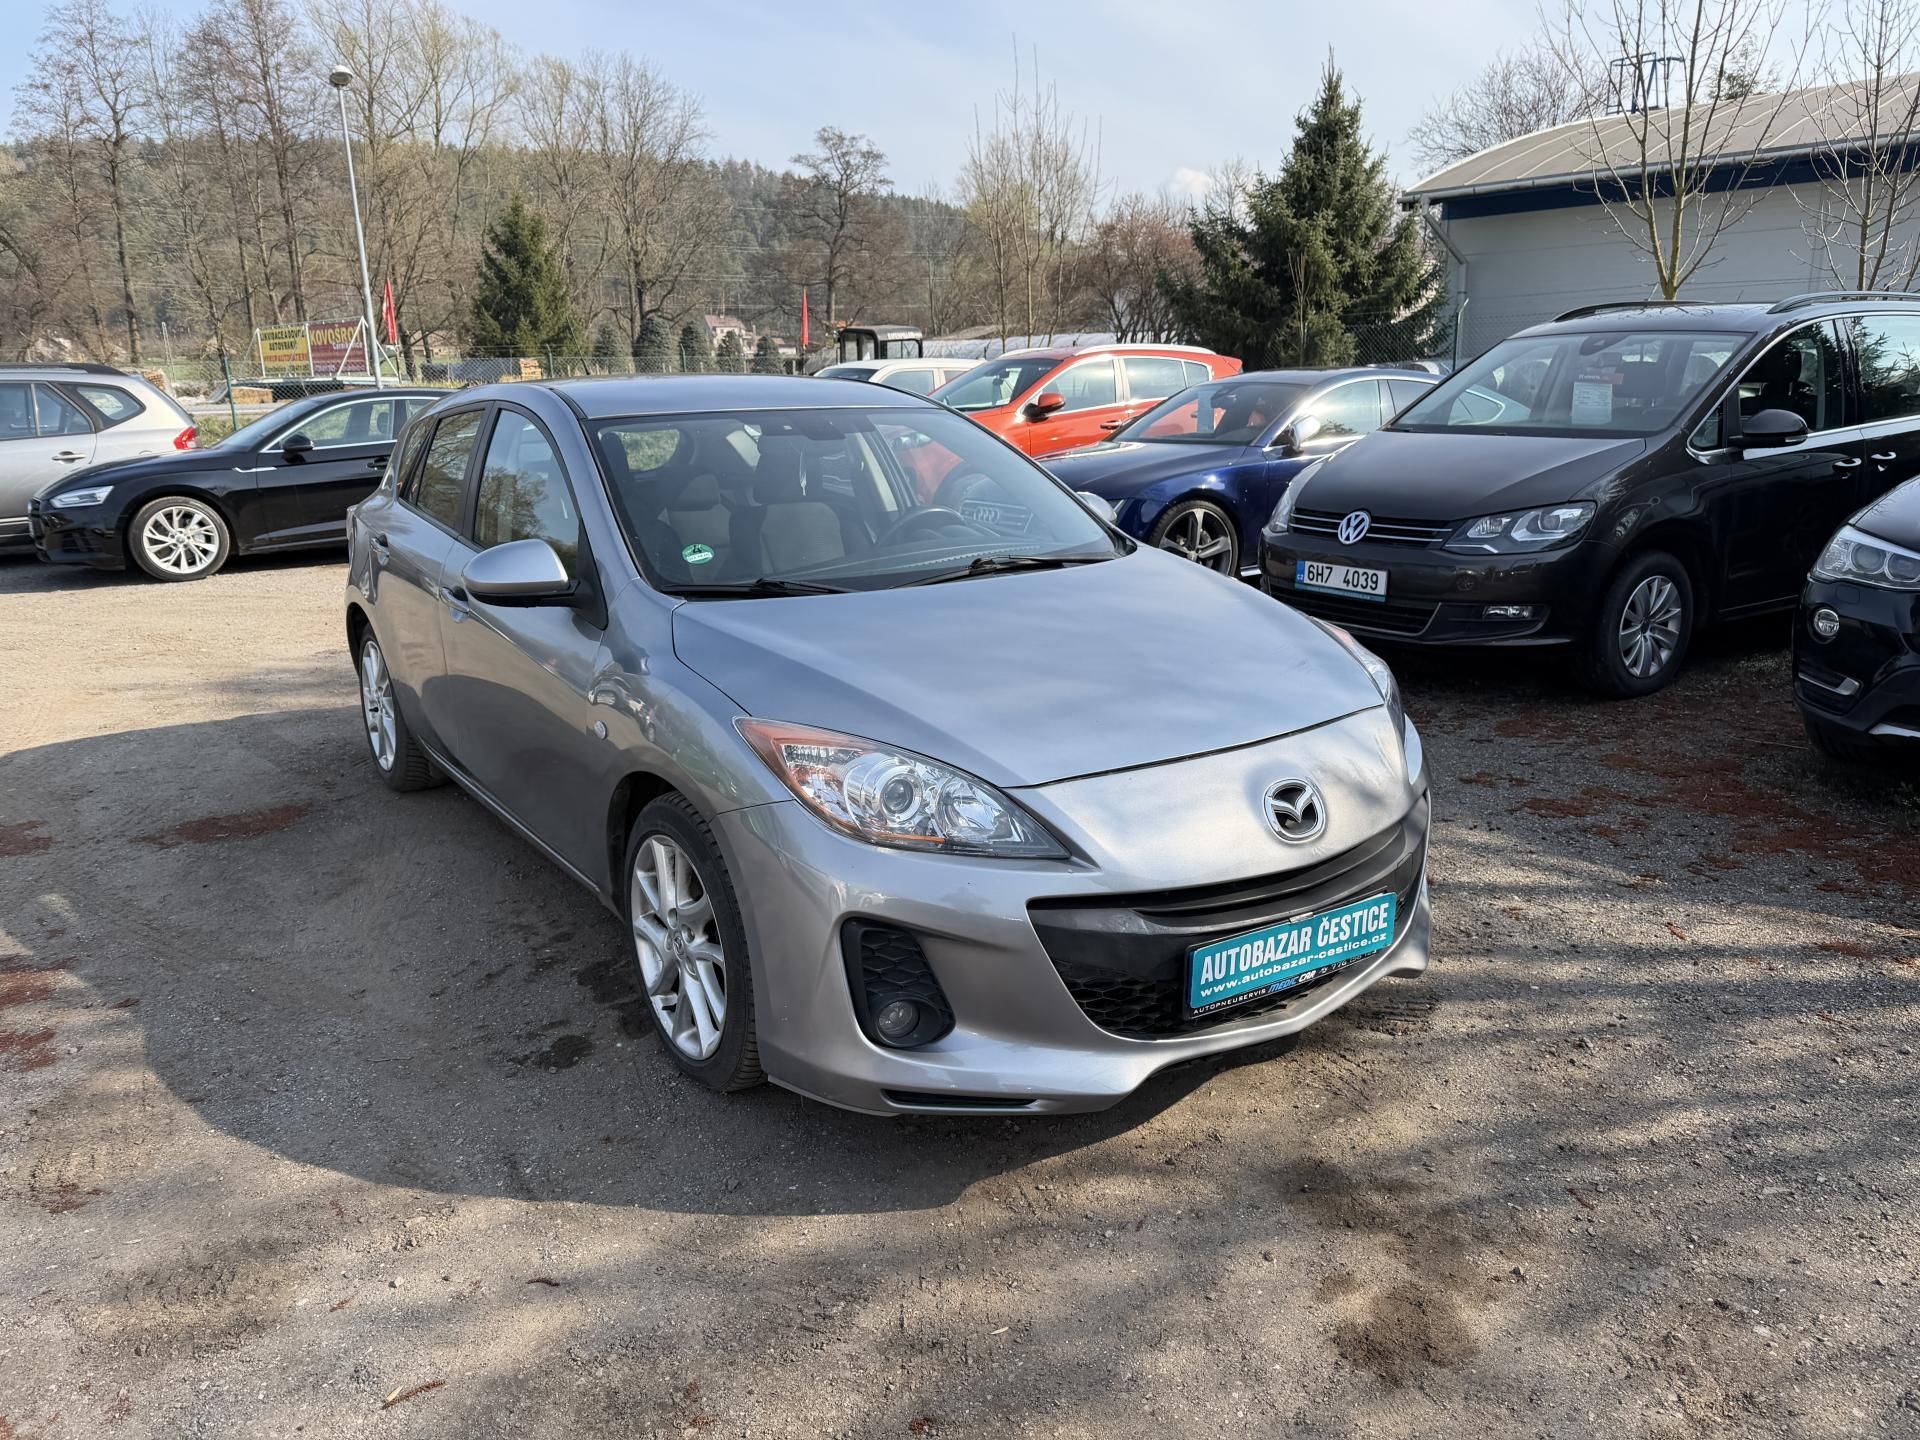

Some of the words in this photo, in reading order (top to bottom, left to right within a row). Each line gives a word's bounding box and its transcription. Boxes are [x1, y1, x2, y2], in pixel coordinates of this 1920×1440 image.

[1307, 564, 1333, 584] 6H7
[1343, 569, 1379, 591] 4039
[1200, 926, 1312, 985] AUTOBAZAR
[1317, 903, 1389, 947] ČESTICE
[1200, 932, 1388, 998] www.autobazar-cestice.cz
[1193, 988, 1266, 1015] AUTOPNEUSERVIS
[1299, 970, 1316, 982] CAR
